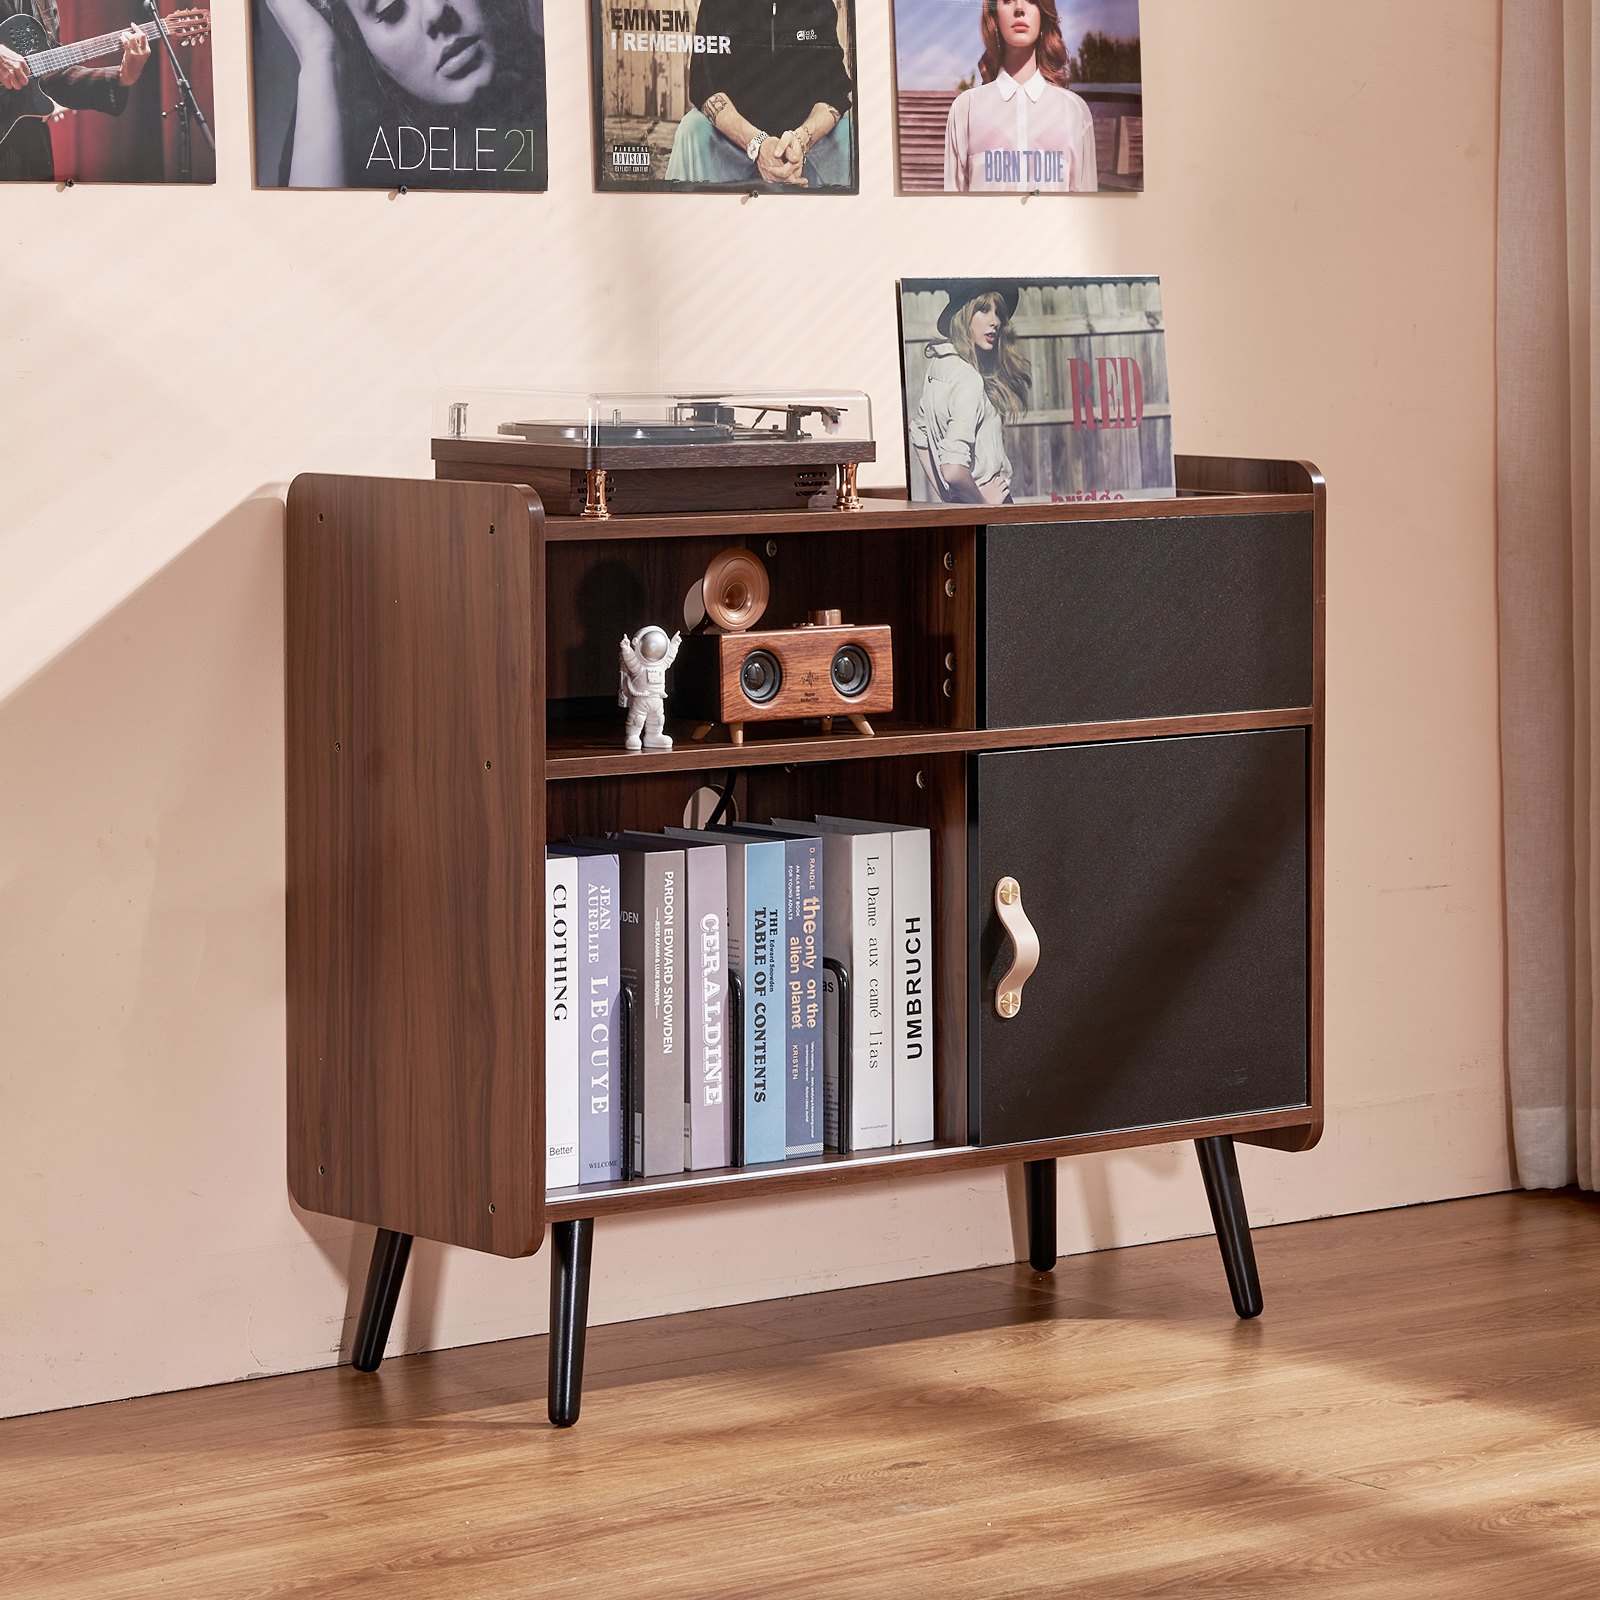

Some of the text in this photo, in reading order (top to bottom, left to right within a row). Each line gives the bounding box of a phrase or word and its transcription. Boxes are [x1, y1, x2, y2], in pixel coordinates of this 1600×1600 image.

[610, 31, 732, 55] I REMEMBER
[366, 125, 535, 172] ADELE 21
[614, 153, 649, 165] ADVISORY
[984, 150, 1065, 183] BORN TO DIE
[1066, 357, 1144, 431] RED
[866, 855, 880, 877] La
[599, 884, 611, 931] JEAN
[769, 909, 778, 936] THE
[867, 886, 880, 928] Dame
[552, 883, 568, 1022] CLOTHING
[663, 871, 674, 1054] PARDON EDWARD SNOWDEN
[802, 895, 821, 1029] the only on the
[868, 937, 879, 967] aux
[587, 882, 610, 1115] AURELIE LECUYE
[754, 907, 767, 1103] TABLE OF CONTENTS
[789, 936, 803, 1030] alien planet
[905, 916, 922, 1059] UMBRUCH
[700, 913, 723, 1107] CERALDINE
[869, 1030, 883, 1070] lias
[548, 1145, 574, 1157] Better
[588, 1159, 619, 1170] WELCOME
